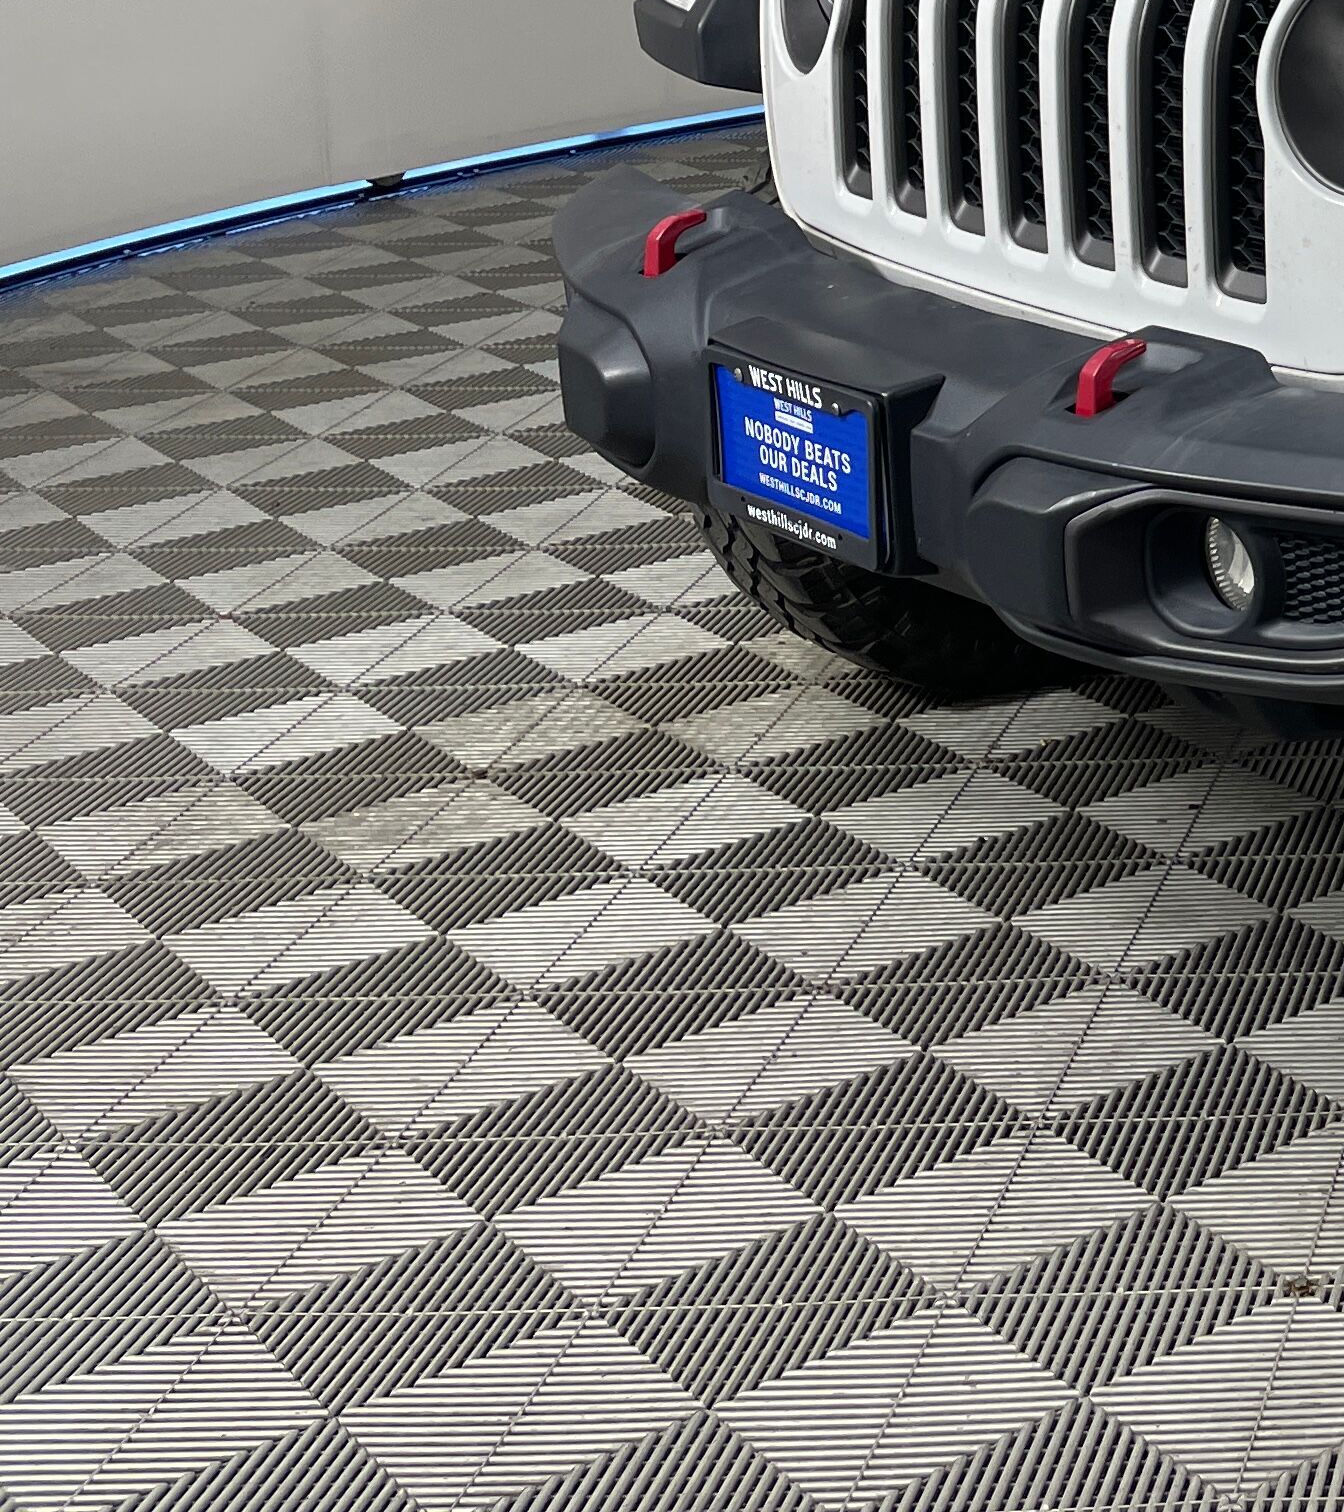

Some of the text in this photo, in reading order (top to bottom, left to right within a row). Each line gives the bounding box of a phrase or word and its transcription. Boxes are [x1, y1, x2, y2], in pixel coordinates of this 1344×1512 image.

[748, 364, 823, 409] WEST HILLS
[773, 397, 793, 414] WEST
[744, 416, 800, 455] NOBODY
[804, 440, 851, 474] BEATS
[759, 445, 838, 492] OUR DEALS
[758, 472, 842, 515] WESTHILLSCJDR.COM
[747, 504, 837, 550] westhillscjdr.com
